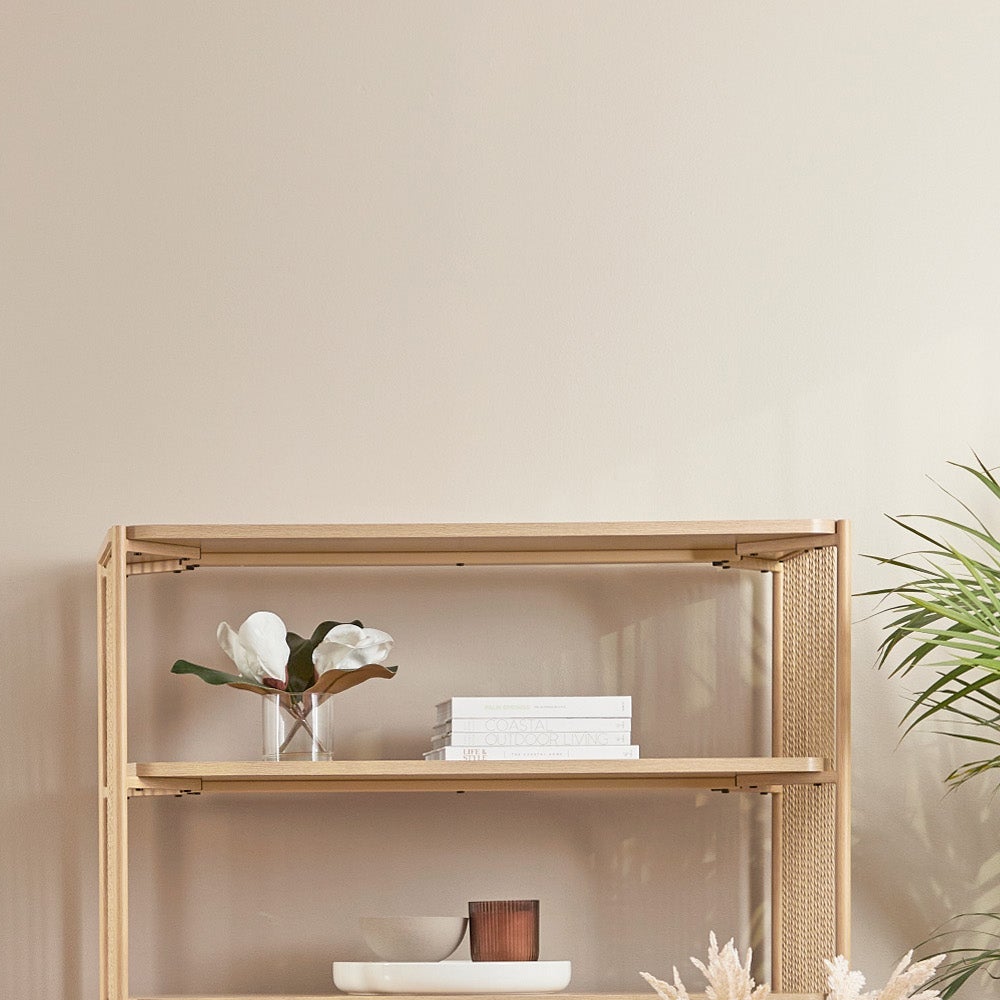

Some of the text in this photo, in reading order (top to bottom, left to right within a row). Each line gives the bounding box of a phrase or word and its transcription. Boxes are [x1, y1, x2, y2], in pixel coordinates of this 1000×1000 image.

[485, 719, 552, 731] COASTAL
[484, 733, 559, 745] OUTDOOR
[563, 733, 609, 745] LIVING
